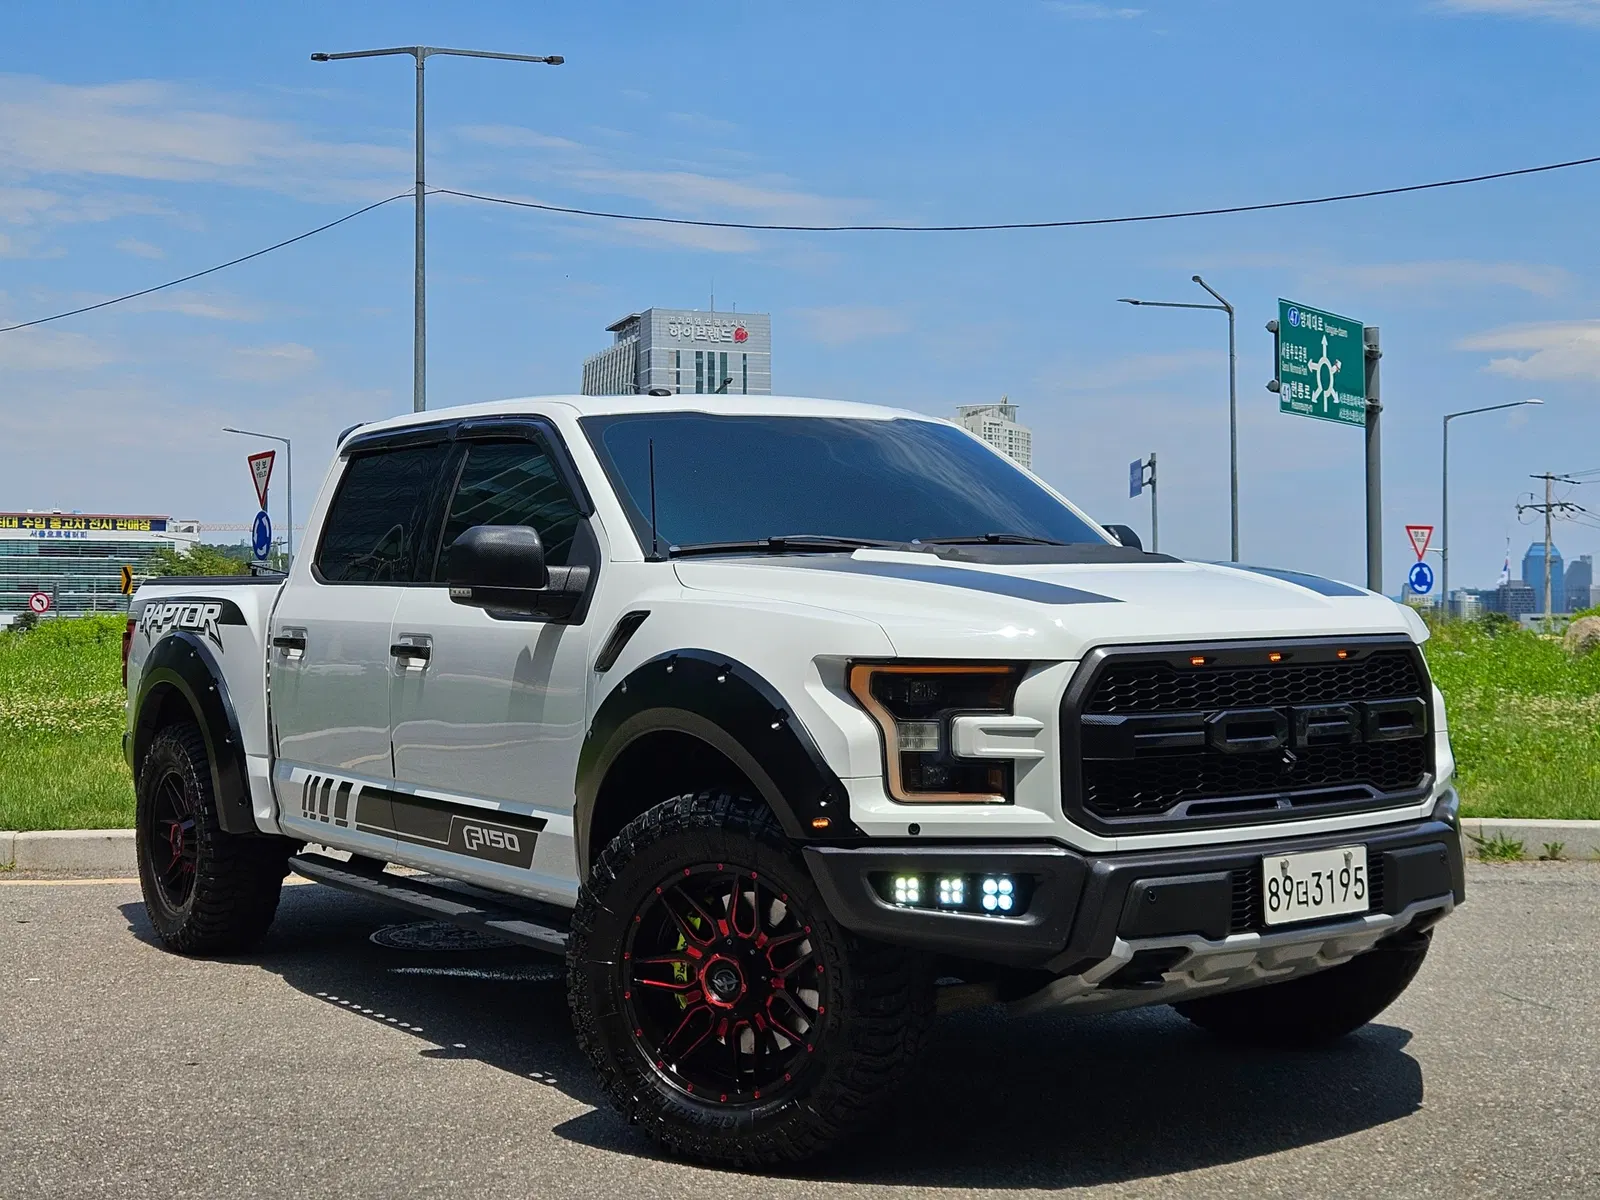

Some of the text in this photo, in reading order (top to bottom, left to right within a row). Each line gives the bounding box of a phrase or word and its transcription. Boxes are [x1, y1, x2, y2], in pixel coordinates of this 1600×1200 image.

[1300, 311, 1324, 331] 양재대로
[669, 325, 733, 343] 하이브랜드
[1281, 342, 1308, 363] 서울추모공원
[255, 460, 267, 471] 양보
[256, 470, 267, 479] YIELD
[22, 517, 46, 530] 수입
[50, 517, 86, 530] 중고차
[89, 518, 112, 531] 전시
[116, 518, 152, 532] 판매장
[29, 530, 88, 539] 서울오토갤러리
[140, 602, 224, 655] RAPTOR
[1081, 697, 1427, 760] FORD
[462, 825, 521, 853] F150
[1268, 866, 1365, 912] 89더3195
